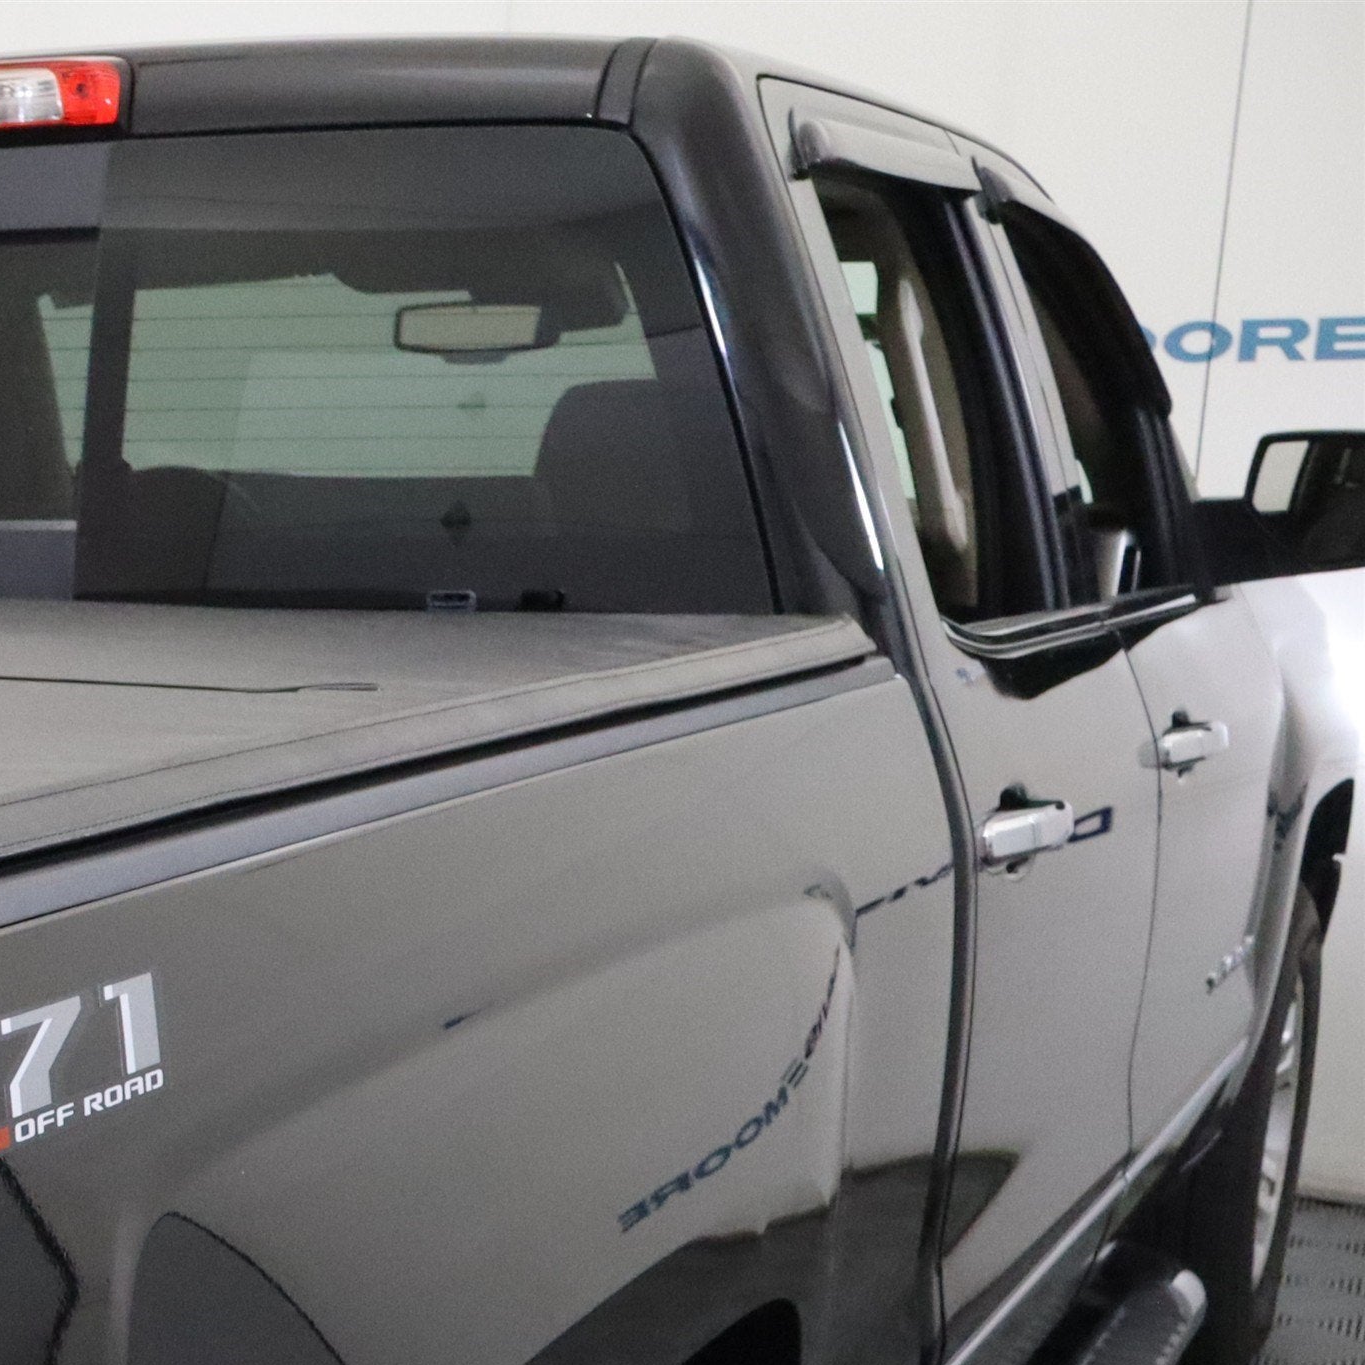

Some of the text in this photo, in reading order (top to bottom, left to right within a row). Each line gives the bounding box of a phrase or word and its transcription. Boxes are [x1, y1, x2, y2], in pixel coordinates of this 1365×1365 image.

[1142, 316, 1365, 363] ORE
[14, 1068, 165, 1143] OFF ROAD
